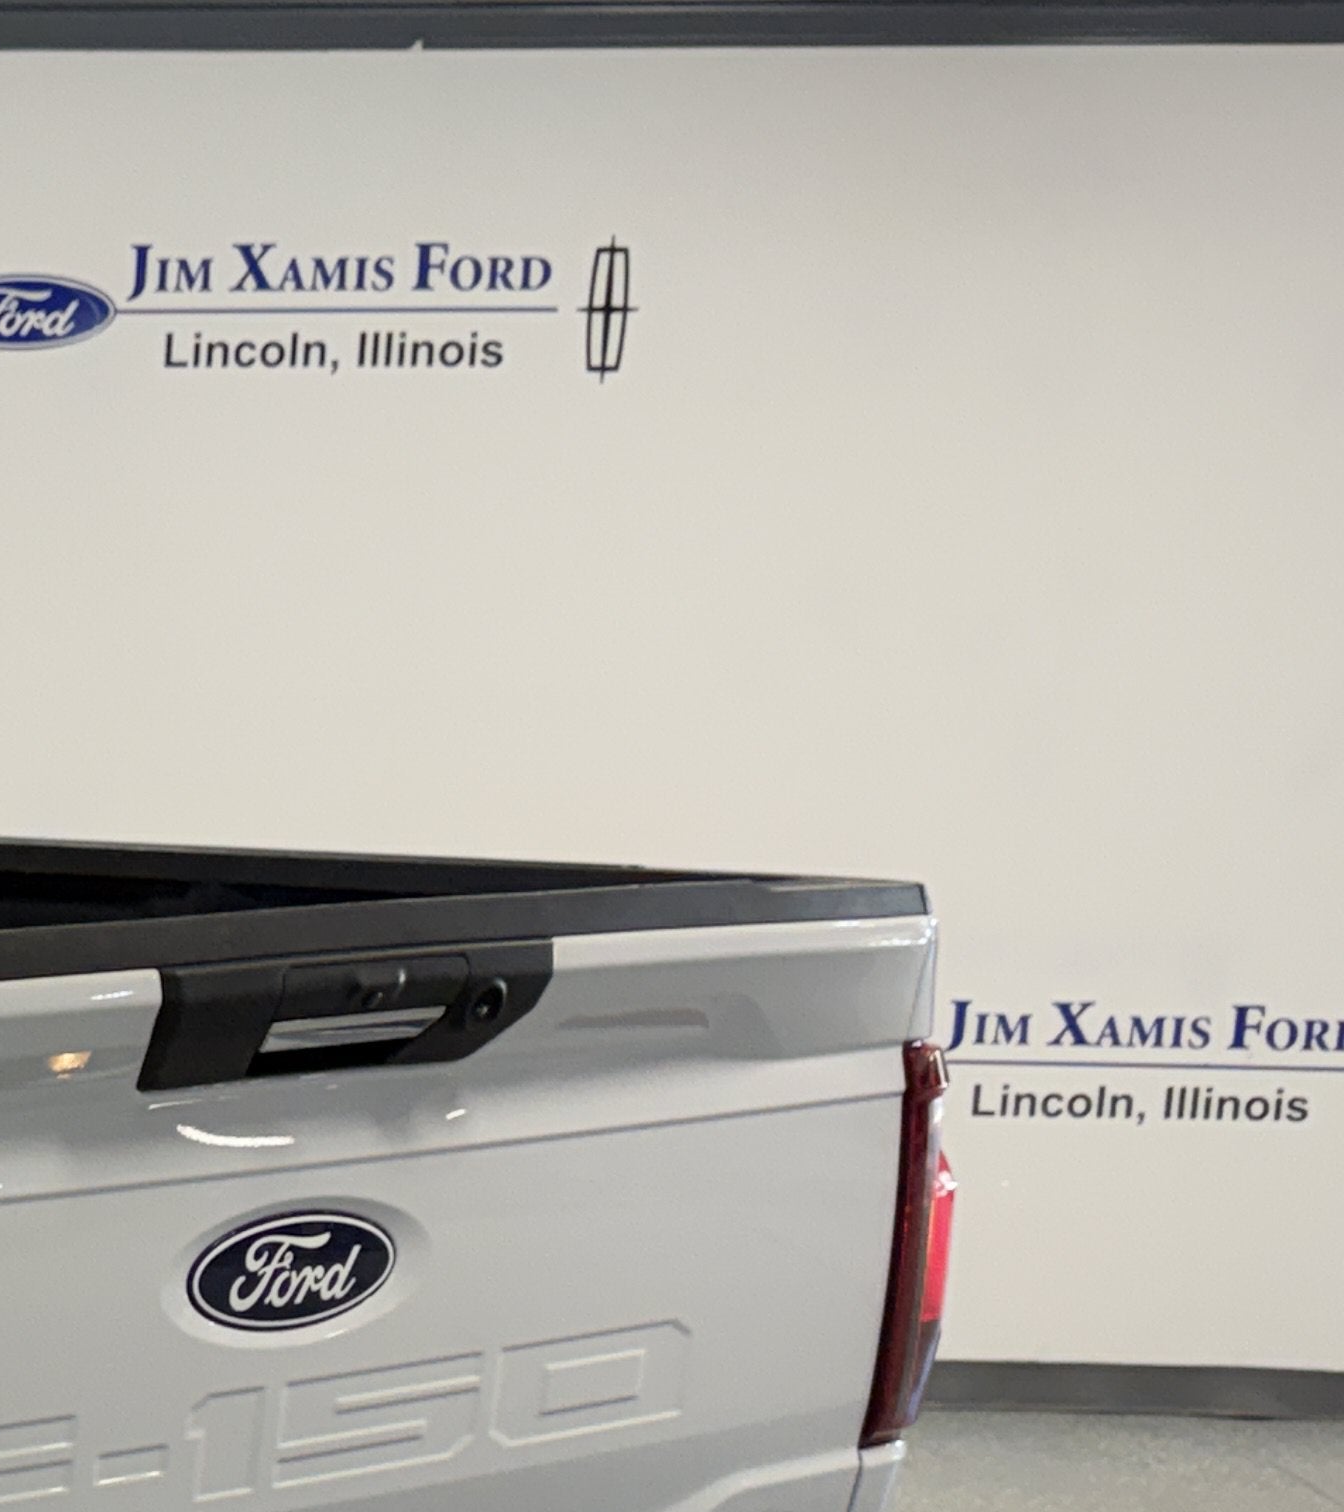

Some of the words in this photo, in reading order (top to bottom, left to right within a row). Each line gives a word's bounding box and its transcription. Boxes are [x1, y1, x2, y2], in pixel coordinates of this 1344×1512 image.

[126, 243, 213, 300] JIM
[229, 243, 395, 293] XAMIS
[412, 243, 552, 292] FORD
[163, 331, 338, 374] Lincoln,
[357, 331, 505, 369] Illinois
[946, 999, 1033, 1053] JIM
[1046, 1000, 1212, 1050] XAMIS
[1227, 1004, 1344, 1052] FOR
[970, 1083, 1146, 1125] Lincoln,
[1163, 1086, 1310, 1123] Illinois
[228, 1230, 362, 1312] Ford
